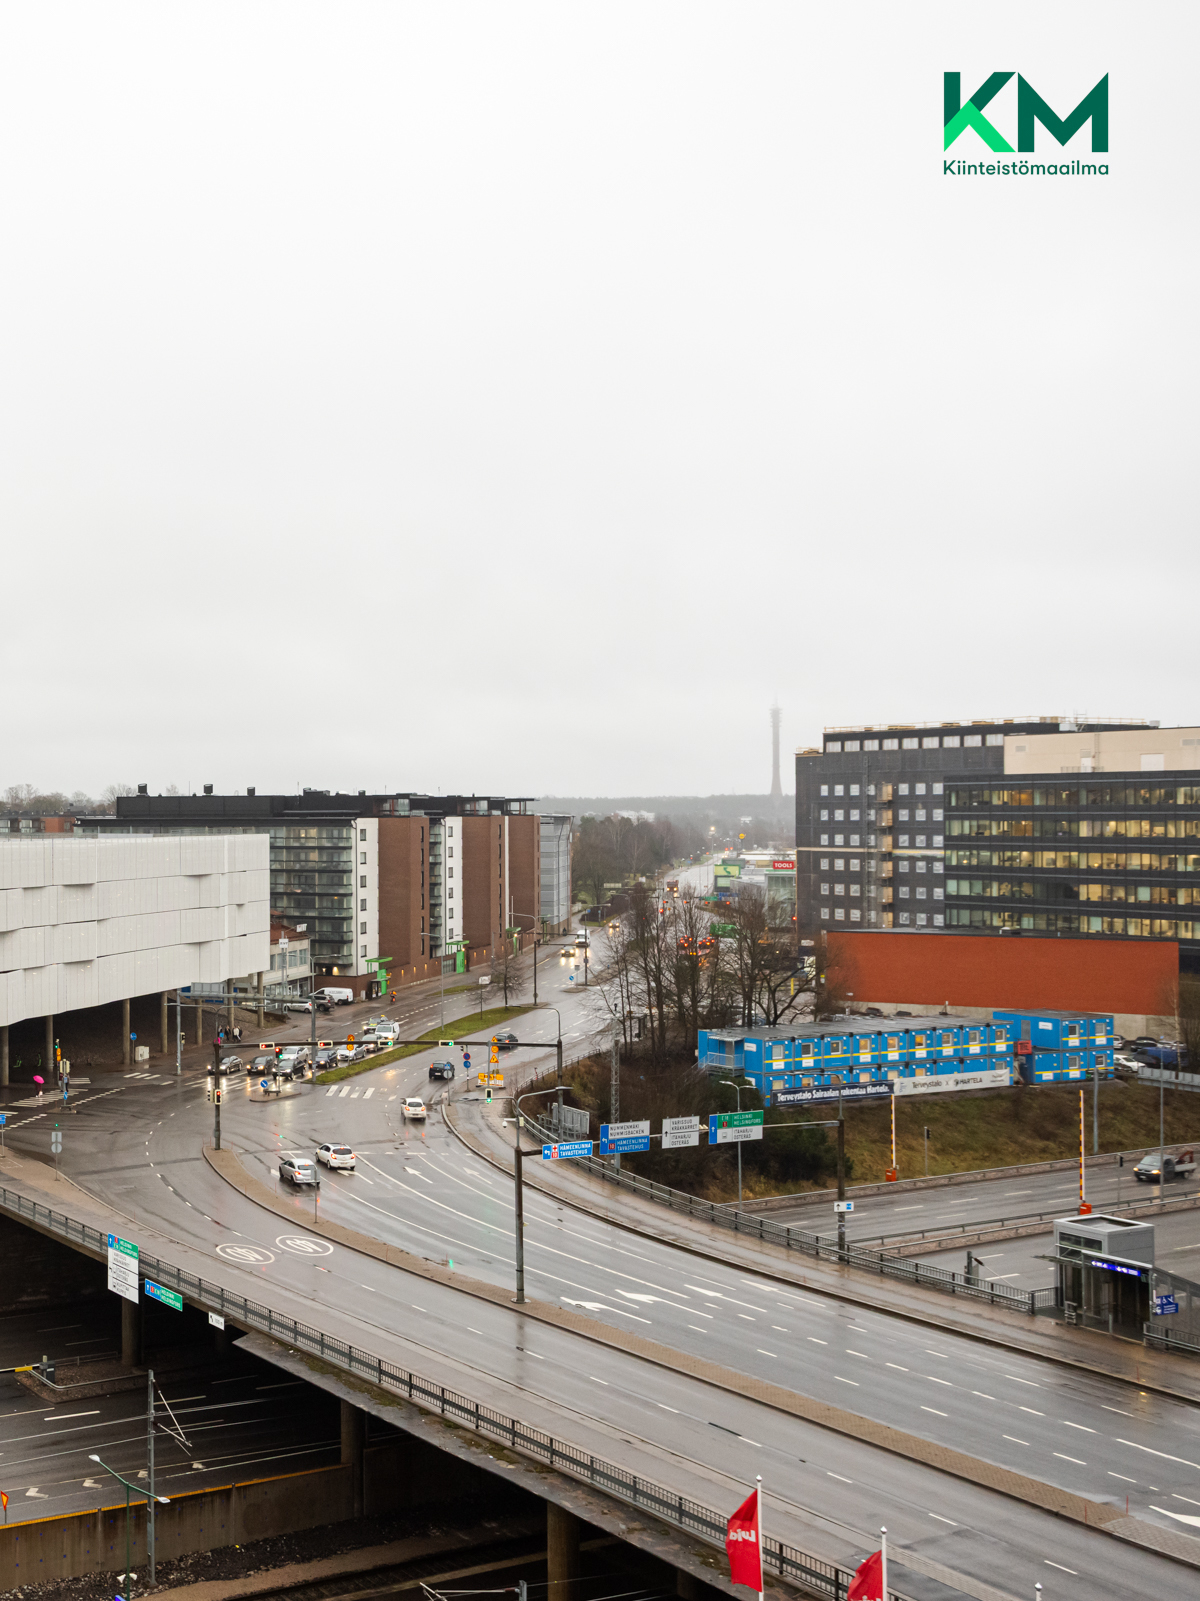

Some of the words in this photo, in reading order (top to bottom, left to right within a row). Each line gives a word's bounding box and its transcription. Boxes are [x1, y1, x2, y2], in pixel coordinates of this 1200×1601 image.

[912, 1079, 942, 1089] Terveystalo
[959, 1077, 982, 1085] HARTELA
[777, 1091, 812, 1102] Terveystalo
